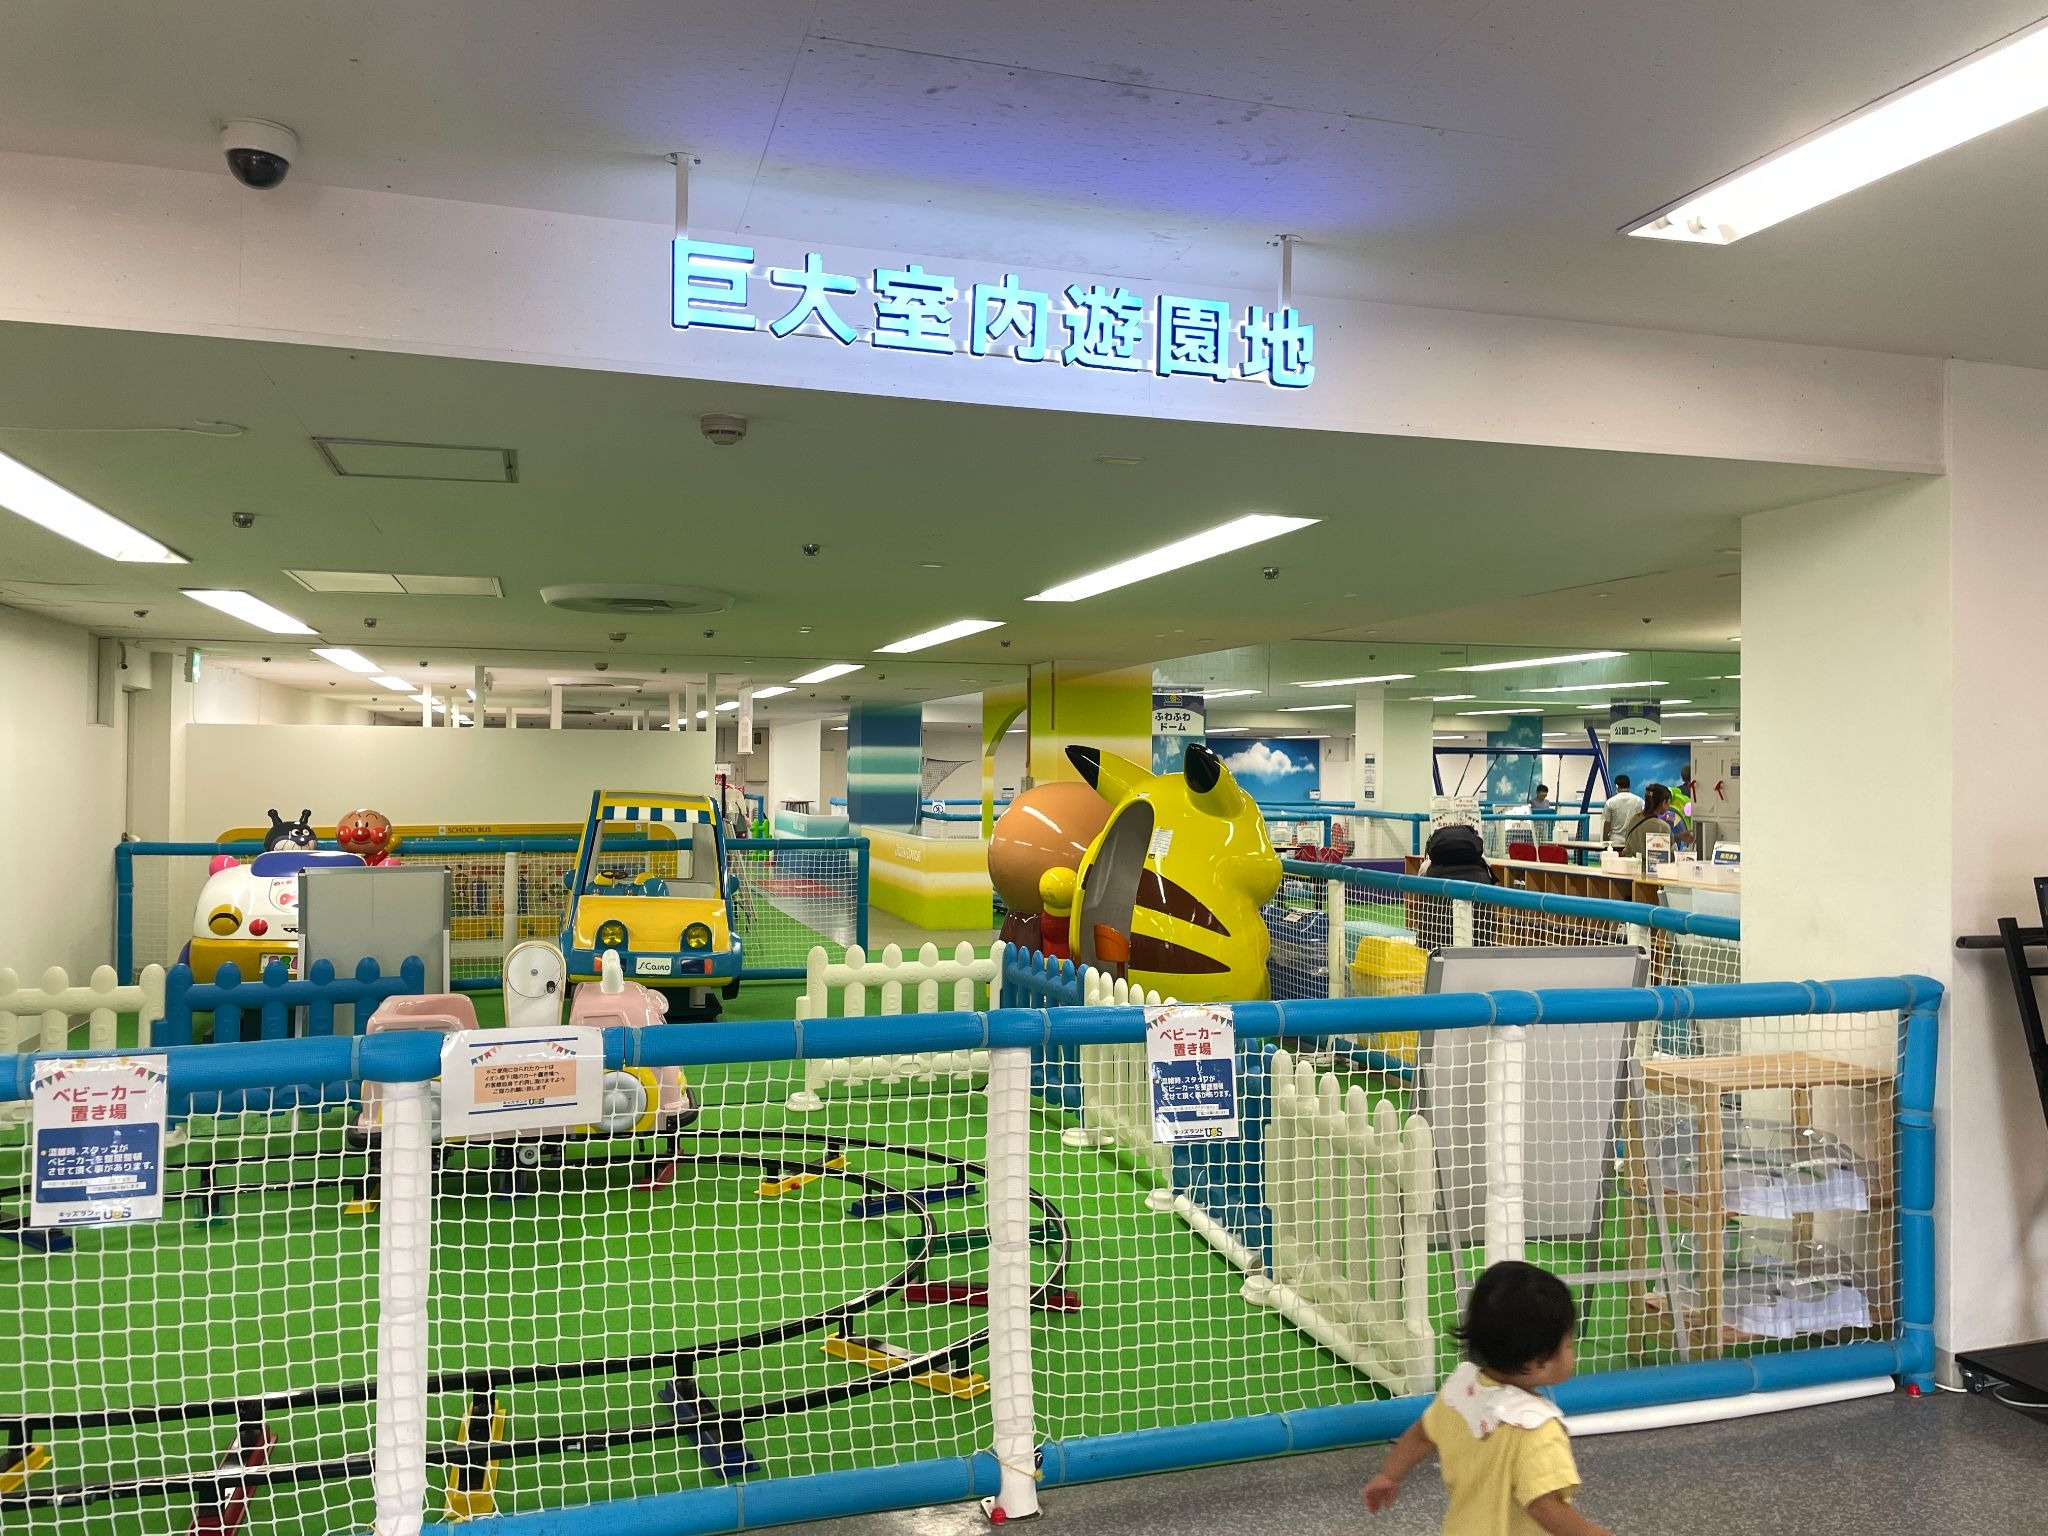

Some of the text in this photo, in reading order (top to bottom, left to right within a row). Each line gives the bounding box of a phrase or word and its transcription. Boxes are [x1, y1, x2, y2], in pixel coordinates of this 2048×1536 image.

[671, 238, 1315, 388] 巨大室内遊園地
[1155, 712, 1191, 722] ふわふわ
[1160, 722, 1186, 732] ドーム
[1614, 726, 1657, 736] 公園コーナー
[1160, 1027, 1222, 1041] ベビーカー
[1173, 1042, 1212, 1057] 置き場
[52, 1085, 147, 1103] ベビーカー
[71, 1103, 128, 1123] 置き場
